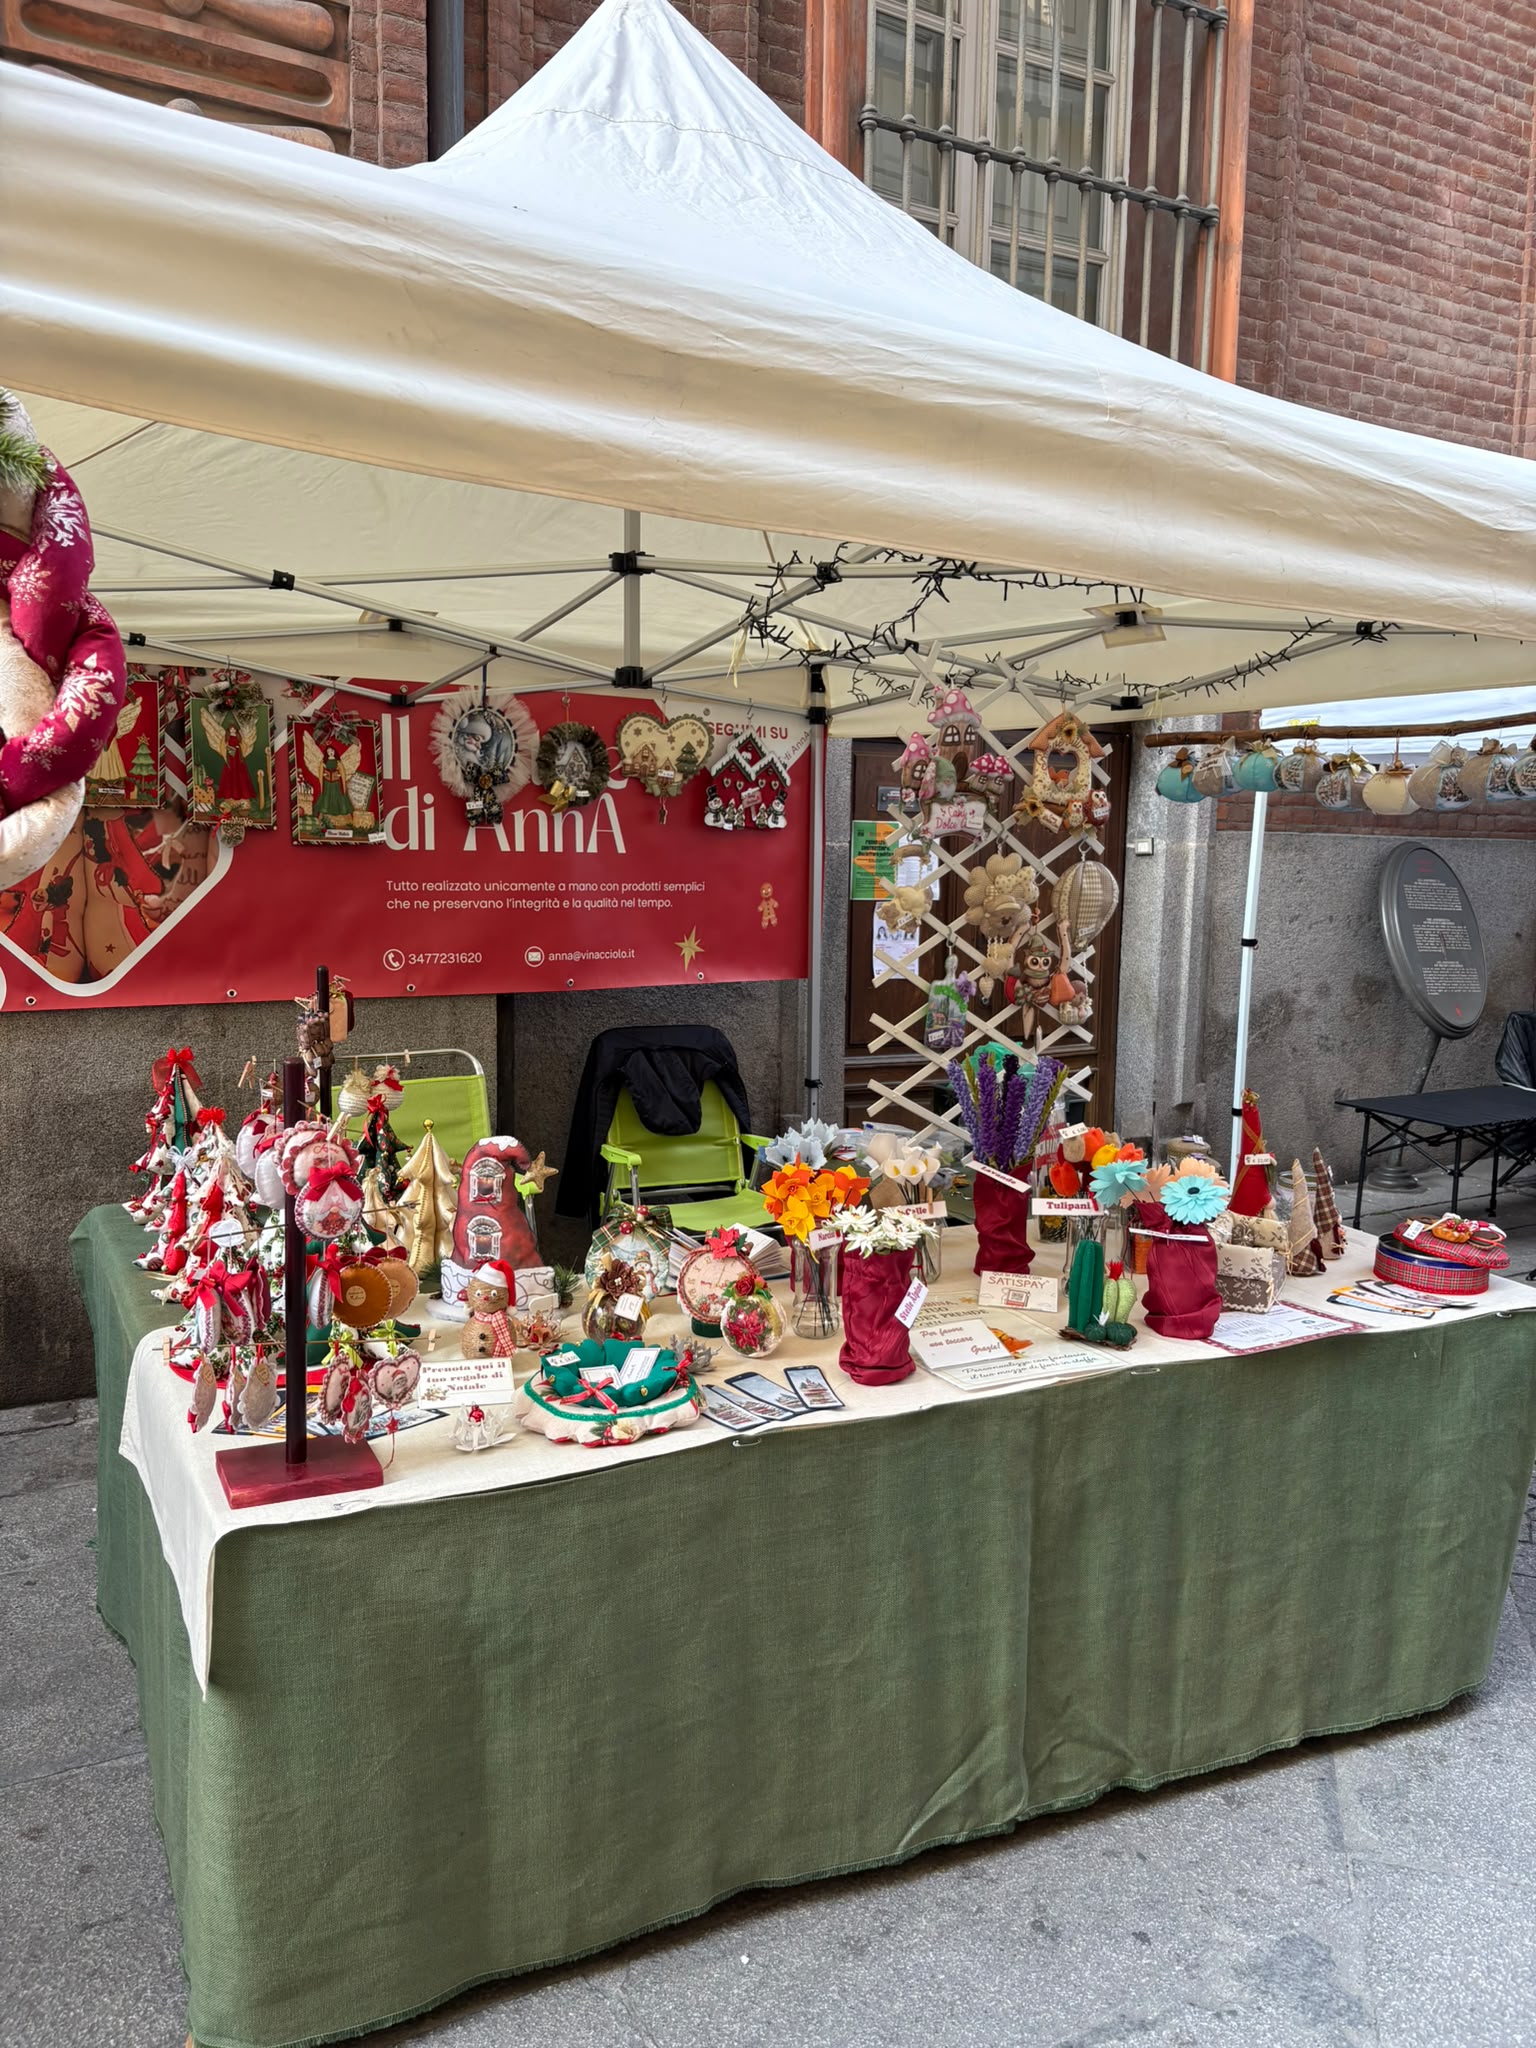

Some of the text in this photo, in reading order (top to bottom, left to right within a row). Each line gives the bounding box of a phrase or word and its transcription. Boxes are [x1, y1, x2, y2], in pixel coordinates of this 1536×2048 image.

[770, 726, 788, 740] SU
[384, 786, 436, 851] di
[386, 880, 705, 893] Tutto realizzato unicamente a mano con prodotti semplici
[386, 898, 411, 909] che
[414, 901, 430, 909] ne
[433, 901, 503, 911] preservano
[562, 900, 570, 908] e
[572, 898, 581, 908] la
[583, 898, 618, 910] qualità
[620, 898, 635, 908] nel
[637, 898, 673, 910] tempo.
[408, 952, 483, 964] 3477231620
[548, 949, 635, 962] anna@vinacciolo.it
[1046, 1202, 1091, 1211] Tulipani
[988, 1276, 1046, 1289] SATISPAY
[900, 1299, 914, 1321] Stelle
[939, 1326, 964, 1337] favore
[946, 1335, 974, 1347] toccare
[422, 1361, 506, 1374] Prenota qui il
[451, 1373, 488, 1381] regalo
[491, 1371, 503, 1379] di
[447, 1383, 486, 1391] Natale
